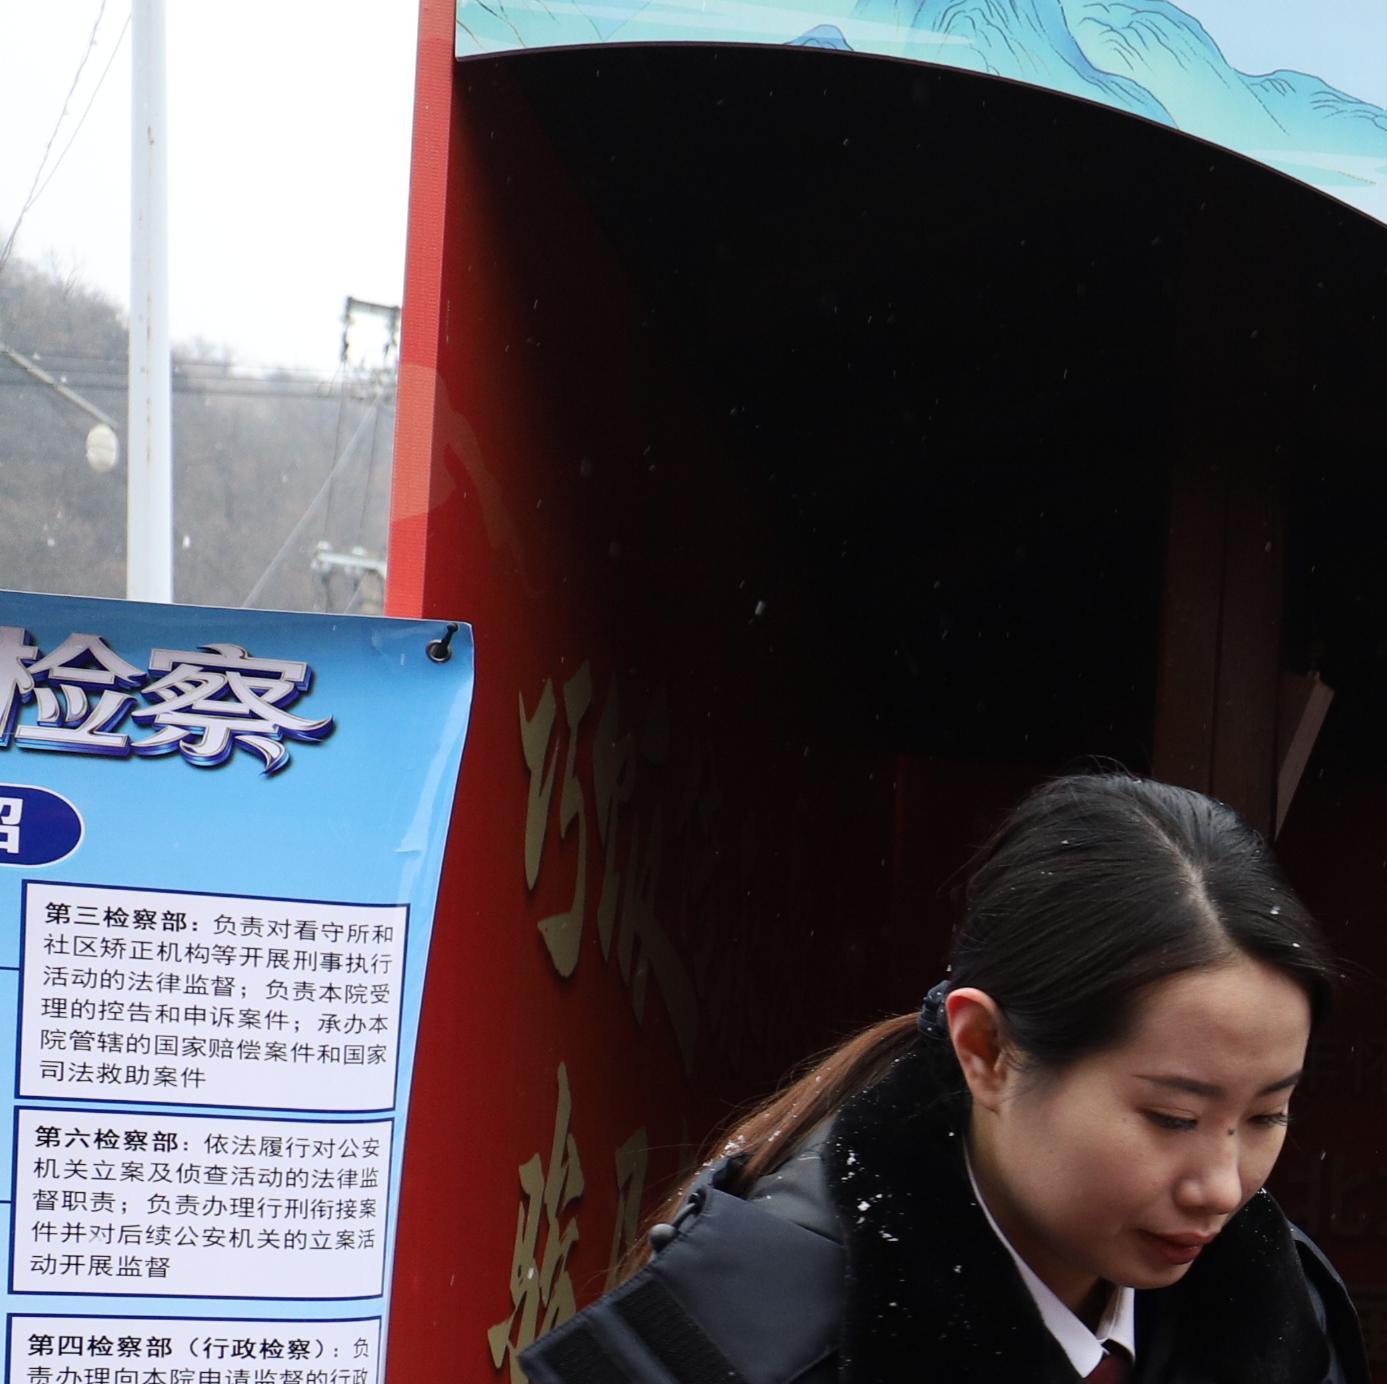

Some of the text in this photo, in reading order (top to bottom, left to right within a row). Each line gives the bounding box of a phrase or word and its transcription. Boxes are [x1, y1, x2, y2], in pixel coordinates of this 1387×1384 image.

[44, 934, 393, 975] 社区矫正机构等开展刑事执行
[43, 966, 391, 1005] 活动的法律监督；负责本院受
[41, 998, 389, 1035] 理的控告和申诉案件；承办本
[39, 1029, 388, 1066] 院管辖的国家赔偿案件和国家
[39, 1060, 207, 1089] 司法救助案件
[33, 1158, 379, 1189] 机关立案及侦查活动的法律监
[32, 1190, 377, 1220] 督职责；负责办理行刑衔接案
[31, 1222, 376, 1250] 件并对后续公安机关的立案活
[30, 1254, 171, 1279] 动开展监督
